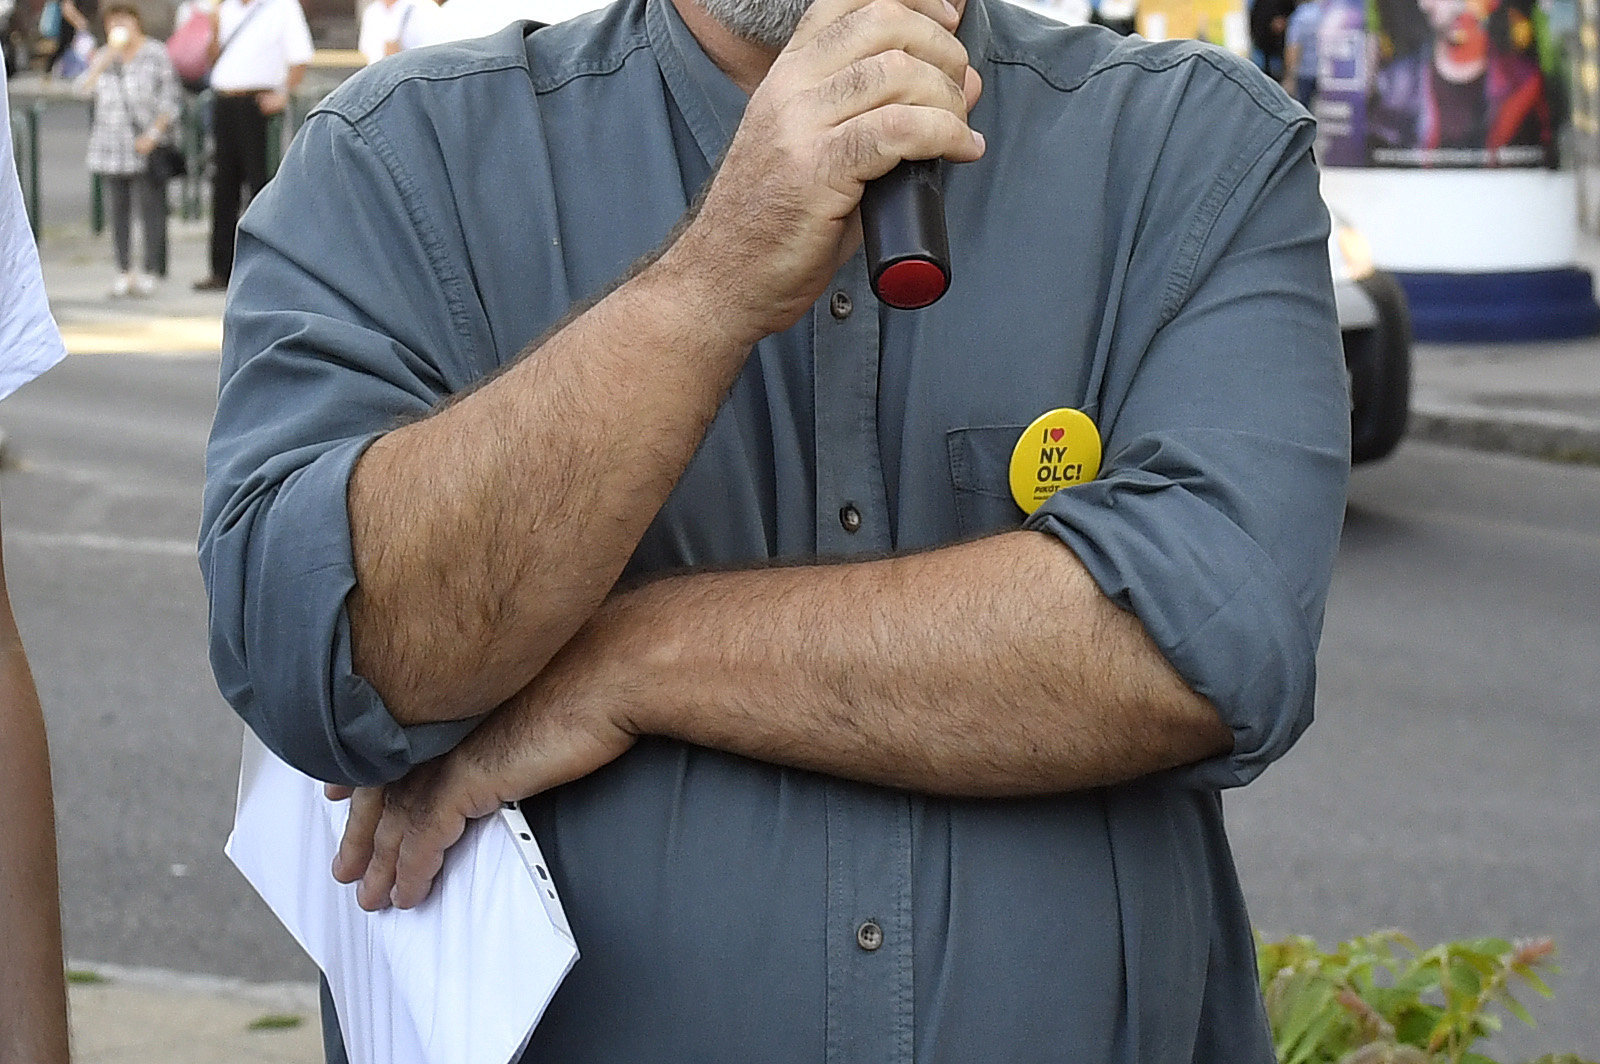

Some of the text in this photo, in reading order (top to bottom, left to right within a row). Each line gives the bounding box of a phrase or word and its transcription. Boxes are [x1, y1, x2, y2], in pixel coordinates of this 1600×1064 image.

[1043, 429, 1048, 444] I
[1041, 447, 1067, 463] NY
[1037, 464, 1082, 481] OLC!
